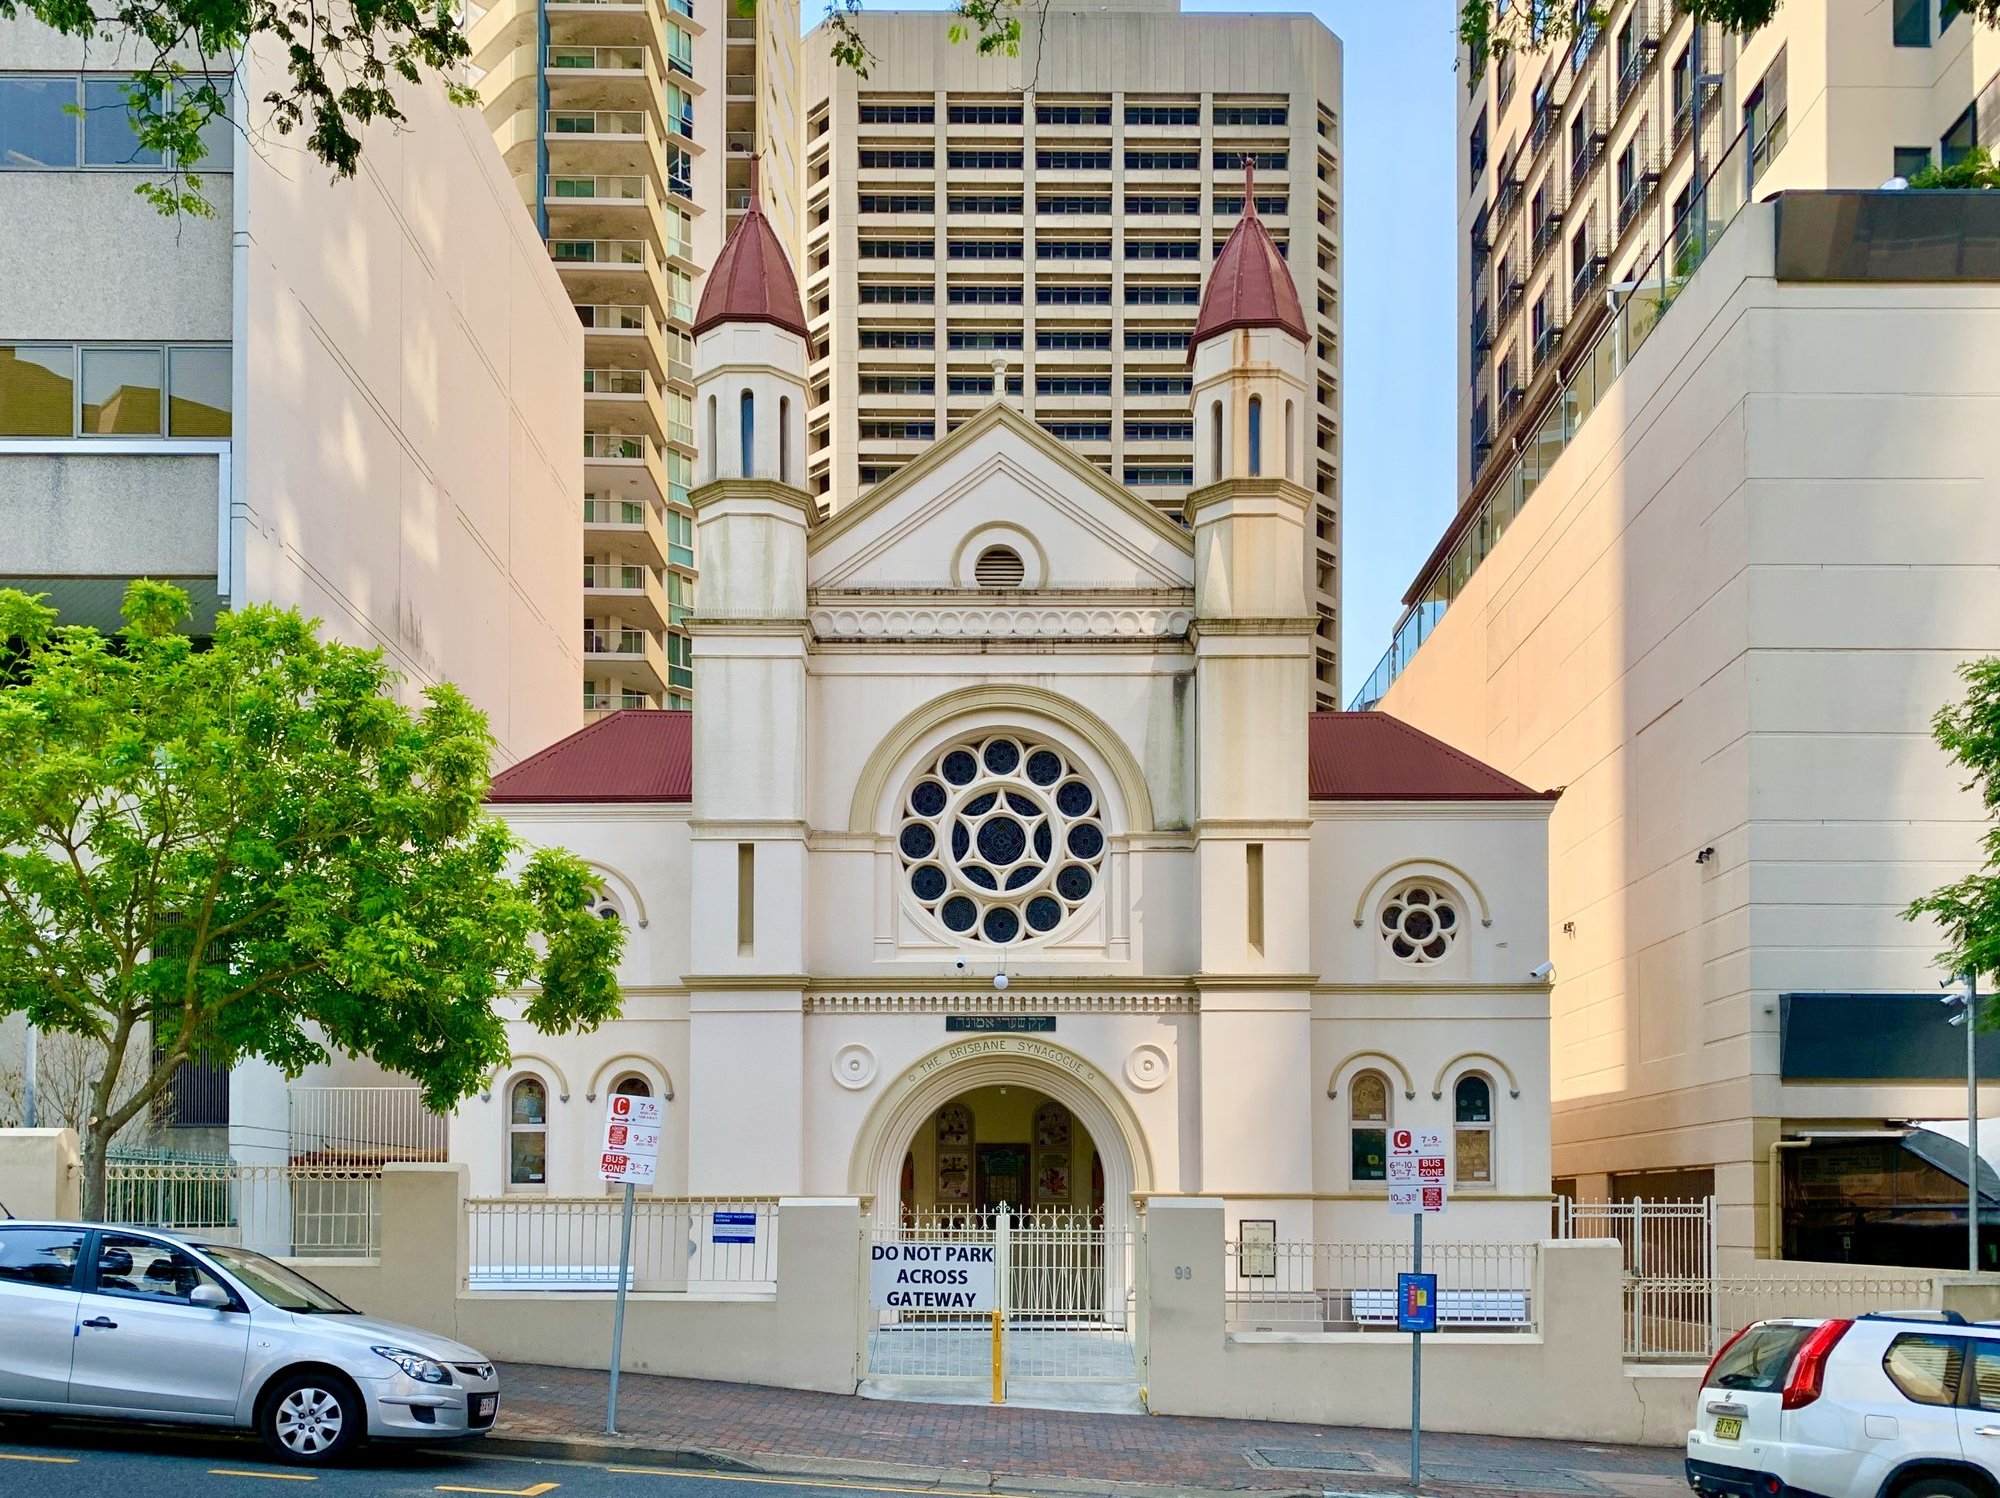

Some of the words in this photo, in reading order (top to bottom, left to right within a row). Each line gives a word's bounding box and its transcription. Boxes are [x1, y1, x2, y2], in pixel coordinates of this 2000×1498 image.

[919, 1056, 942, 1073] THE
[949, 1040, 1006, 1059] BRISBANE
[1018, 1041, 1084, 1073] SYNAGOGUE
[617, 1099, 627, 1114] C
[1397, 1131, 1408, 1147] C
[605, 1155, 624, 1164] BUS
[1422, 1159, 1441, 1167] BUS
[601, 1163, 626, 1173] ZONE
[1420, 1168, 1443, 1176] ZONE
[871, 1245, 899, 1261] DO
[903, 1245, 941, 1262] NOT
[945, 1246, 994, 1263] PARK
[896, 1268, 968, 1285] ACROSS
[886, 1291, 977, 1308] GATEWAY
